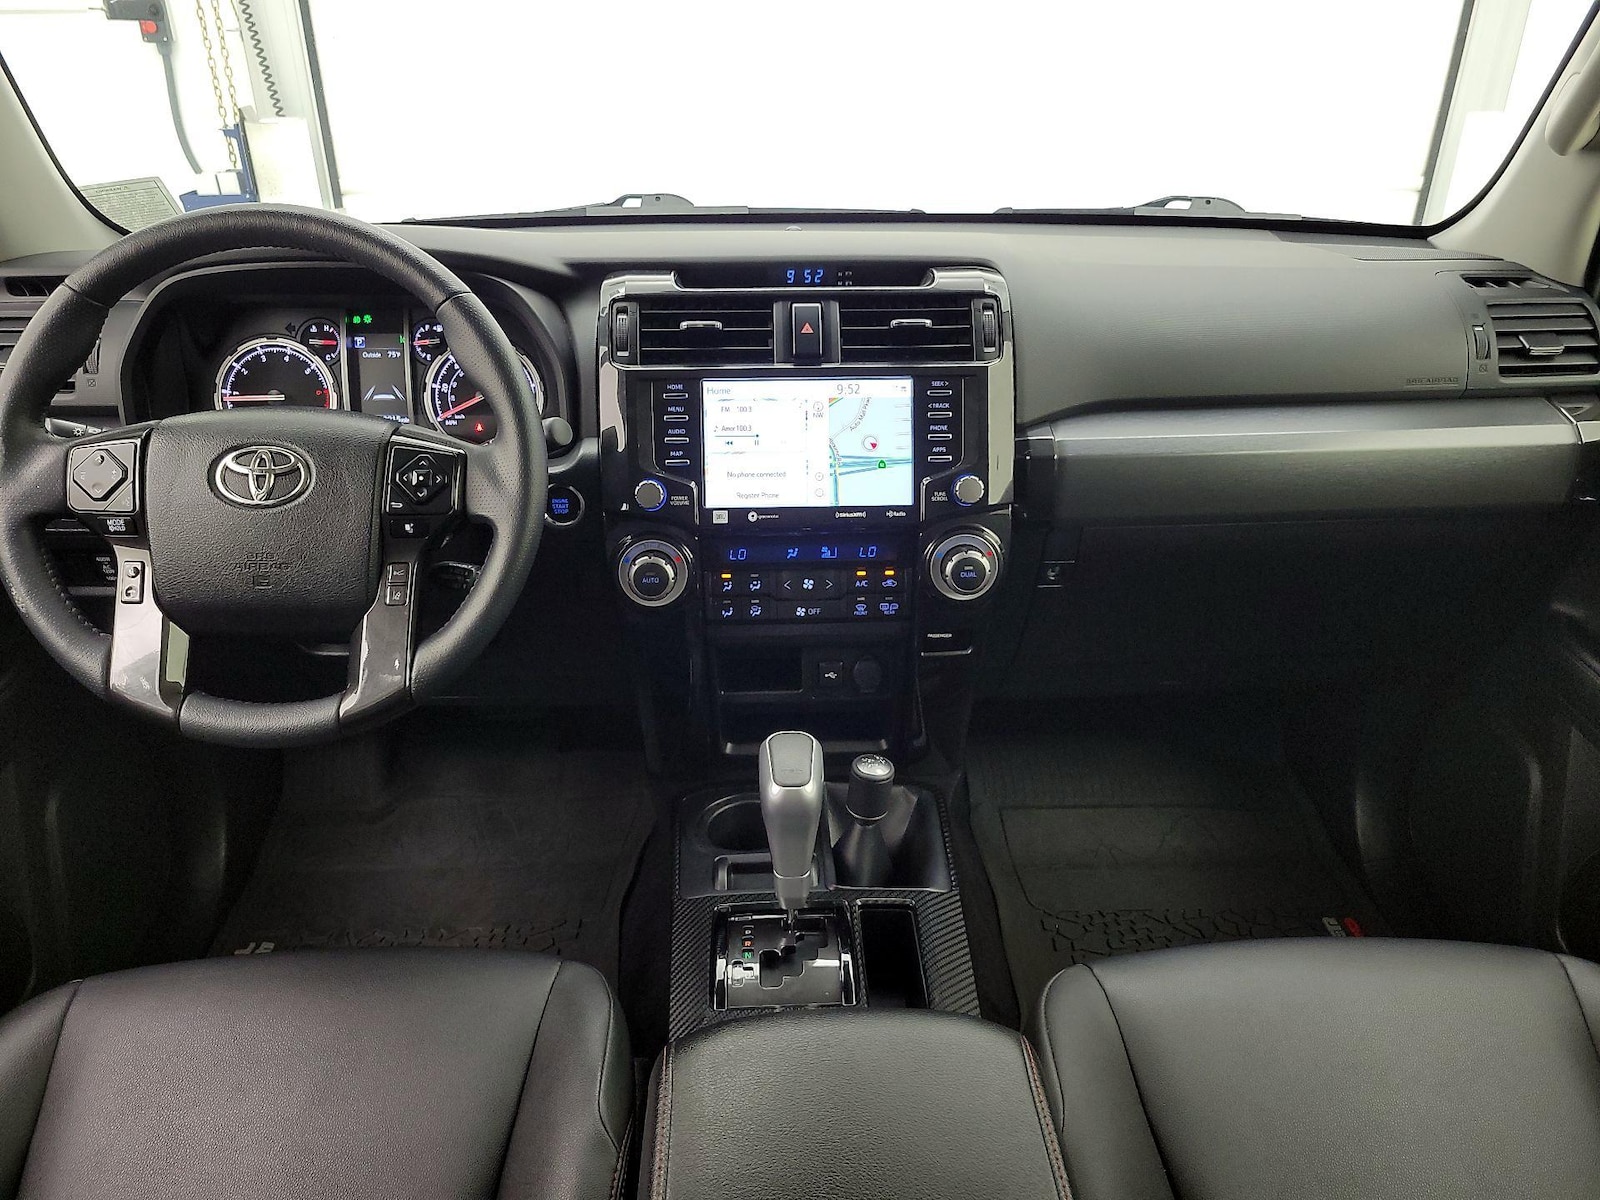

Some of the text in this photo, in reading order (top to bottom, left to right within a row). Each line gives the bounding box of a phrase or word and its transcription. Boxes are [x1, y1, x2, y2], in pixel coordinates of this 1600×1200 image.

[441, 382, 449, 394] 20
[706, 387, 731, 395] Home
[836, 384, 860, 394] 9:52
[855, 580, 868, 588] A/C
